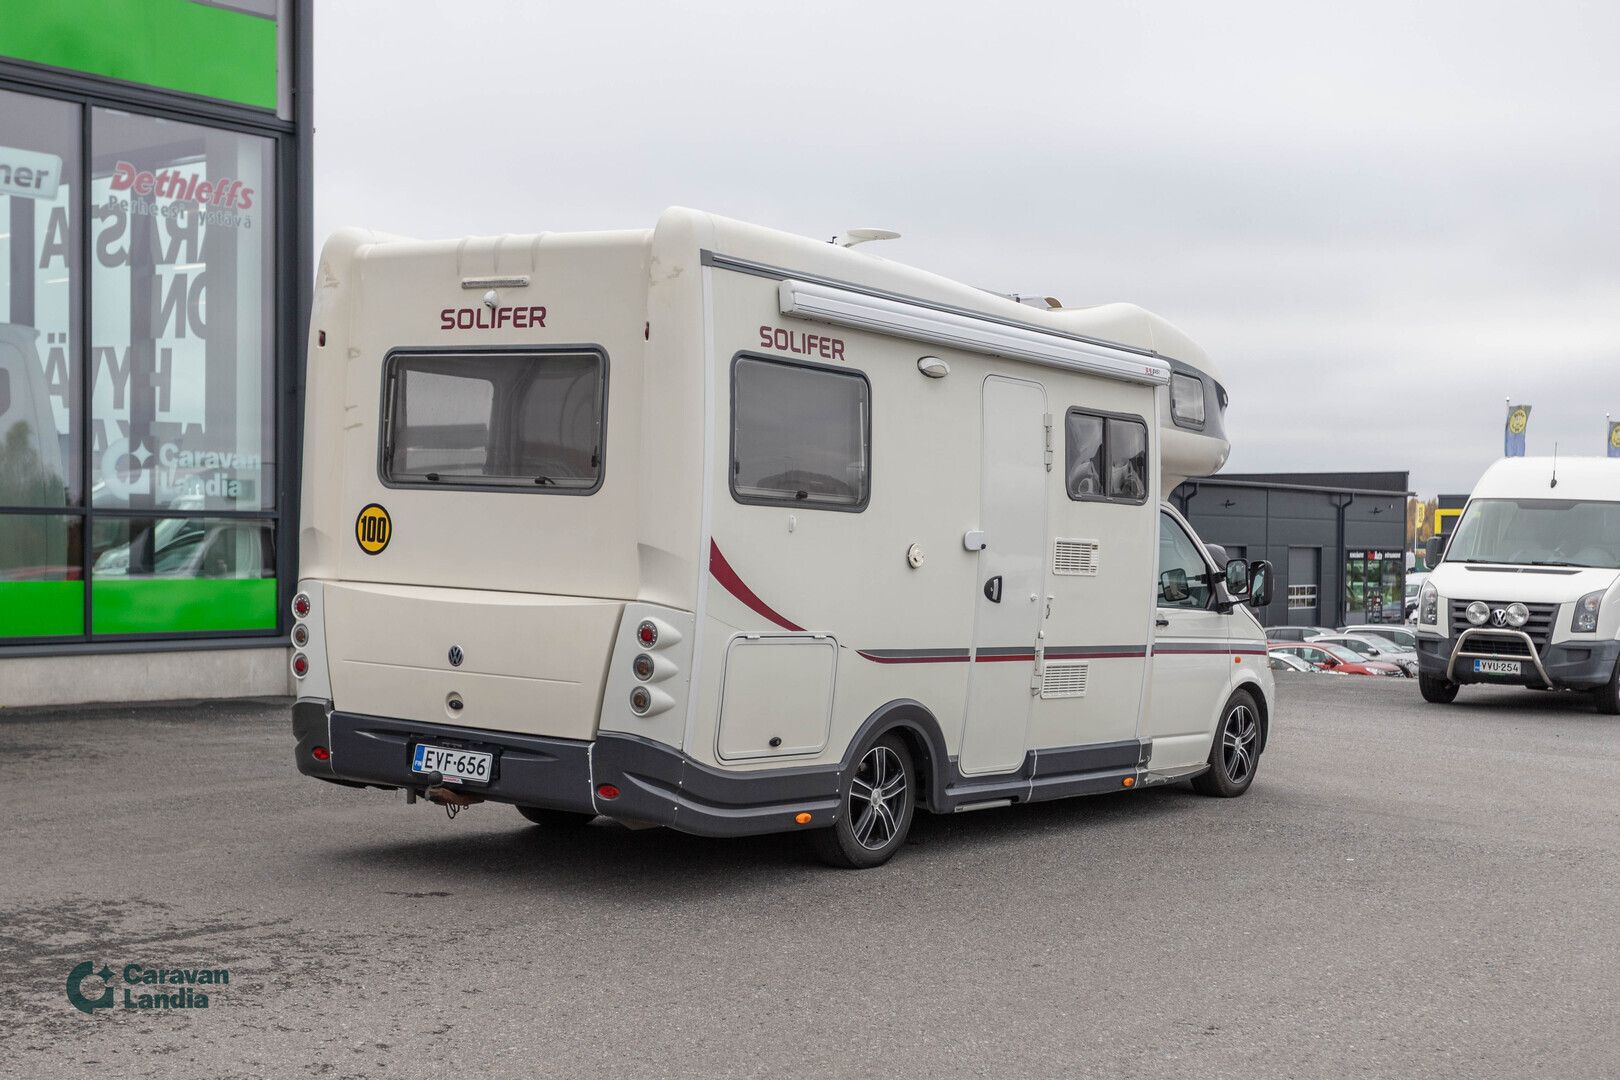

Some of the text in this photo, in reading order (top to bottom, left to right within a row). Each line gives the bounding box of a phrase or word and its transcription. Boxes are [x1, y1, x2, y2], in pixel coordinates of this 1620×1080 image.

[109, 160, 255, 210] Dethleffs
[441, 306, 547, 330] SOLIFER
[760, 325, 845, 361] SOLIFER
[159, 443, 260, 471] Caravan
[361, 516, 386, 543] 100
[424, 750, 486, 776] EVF-656
